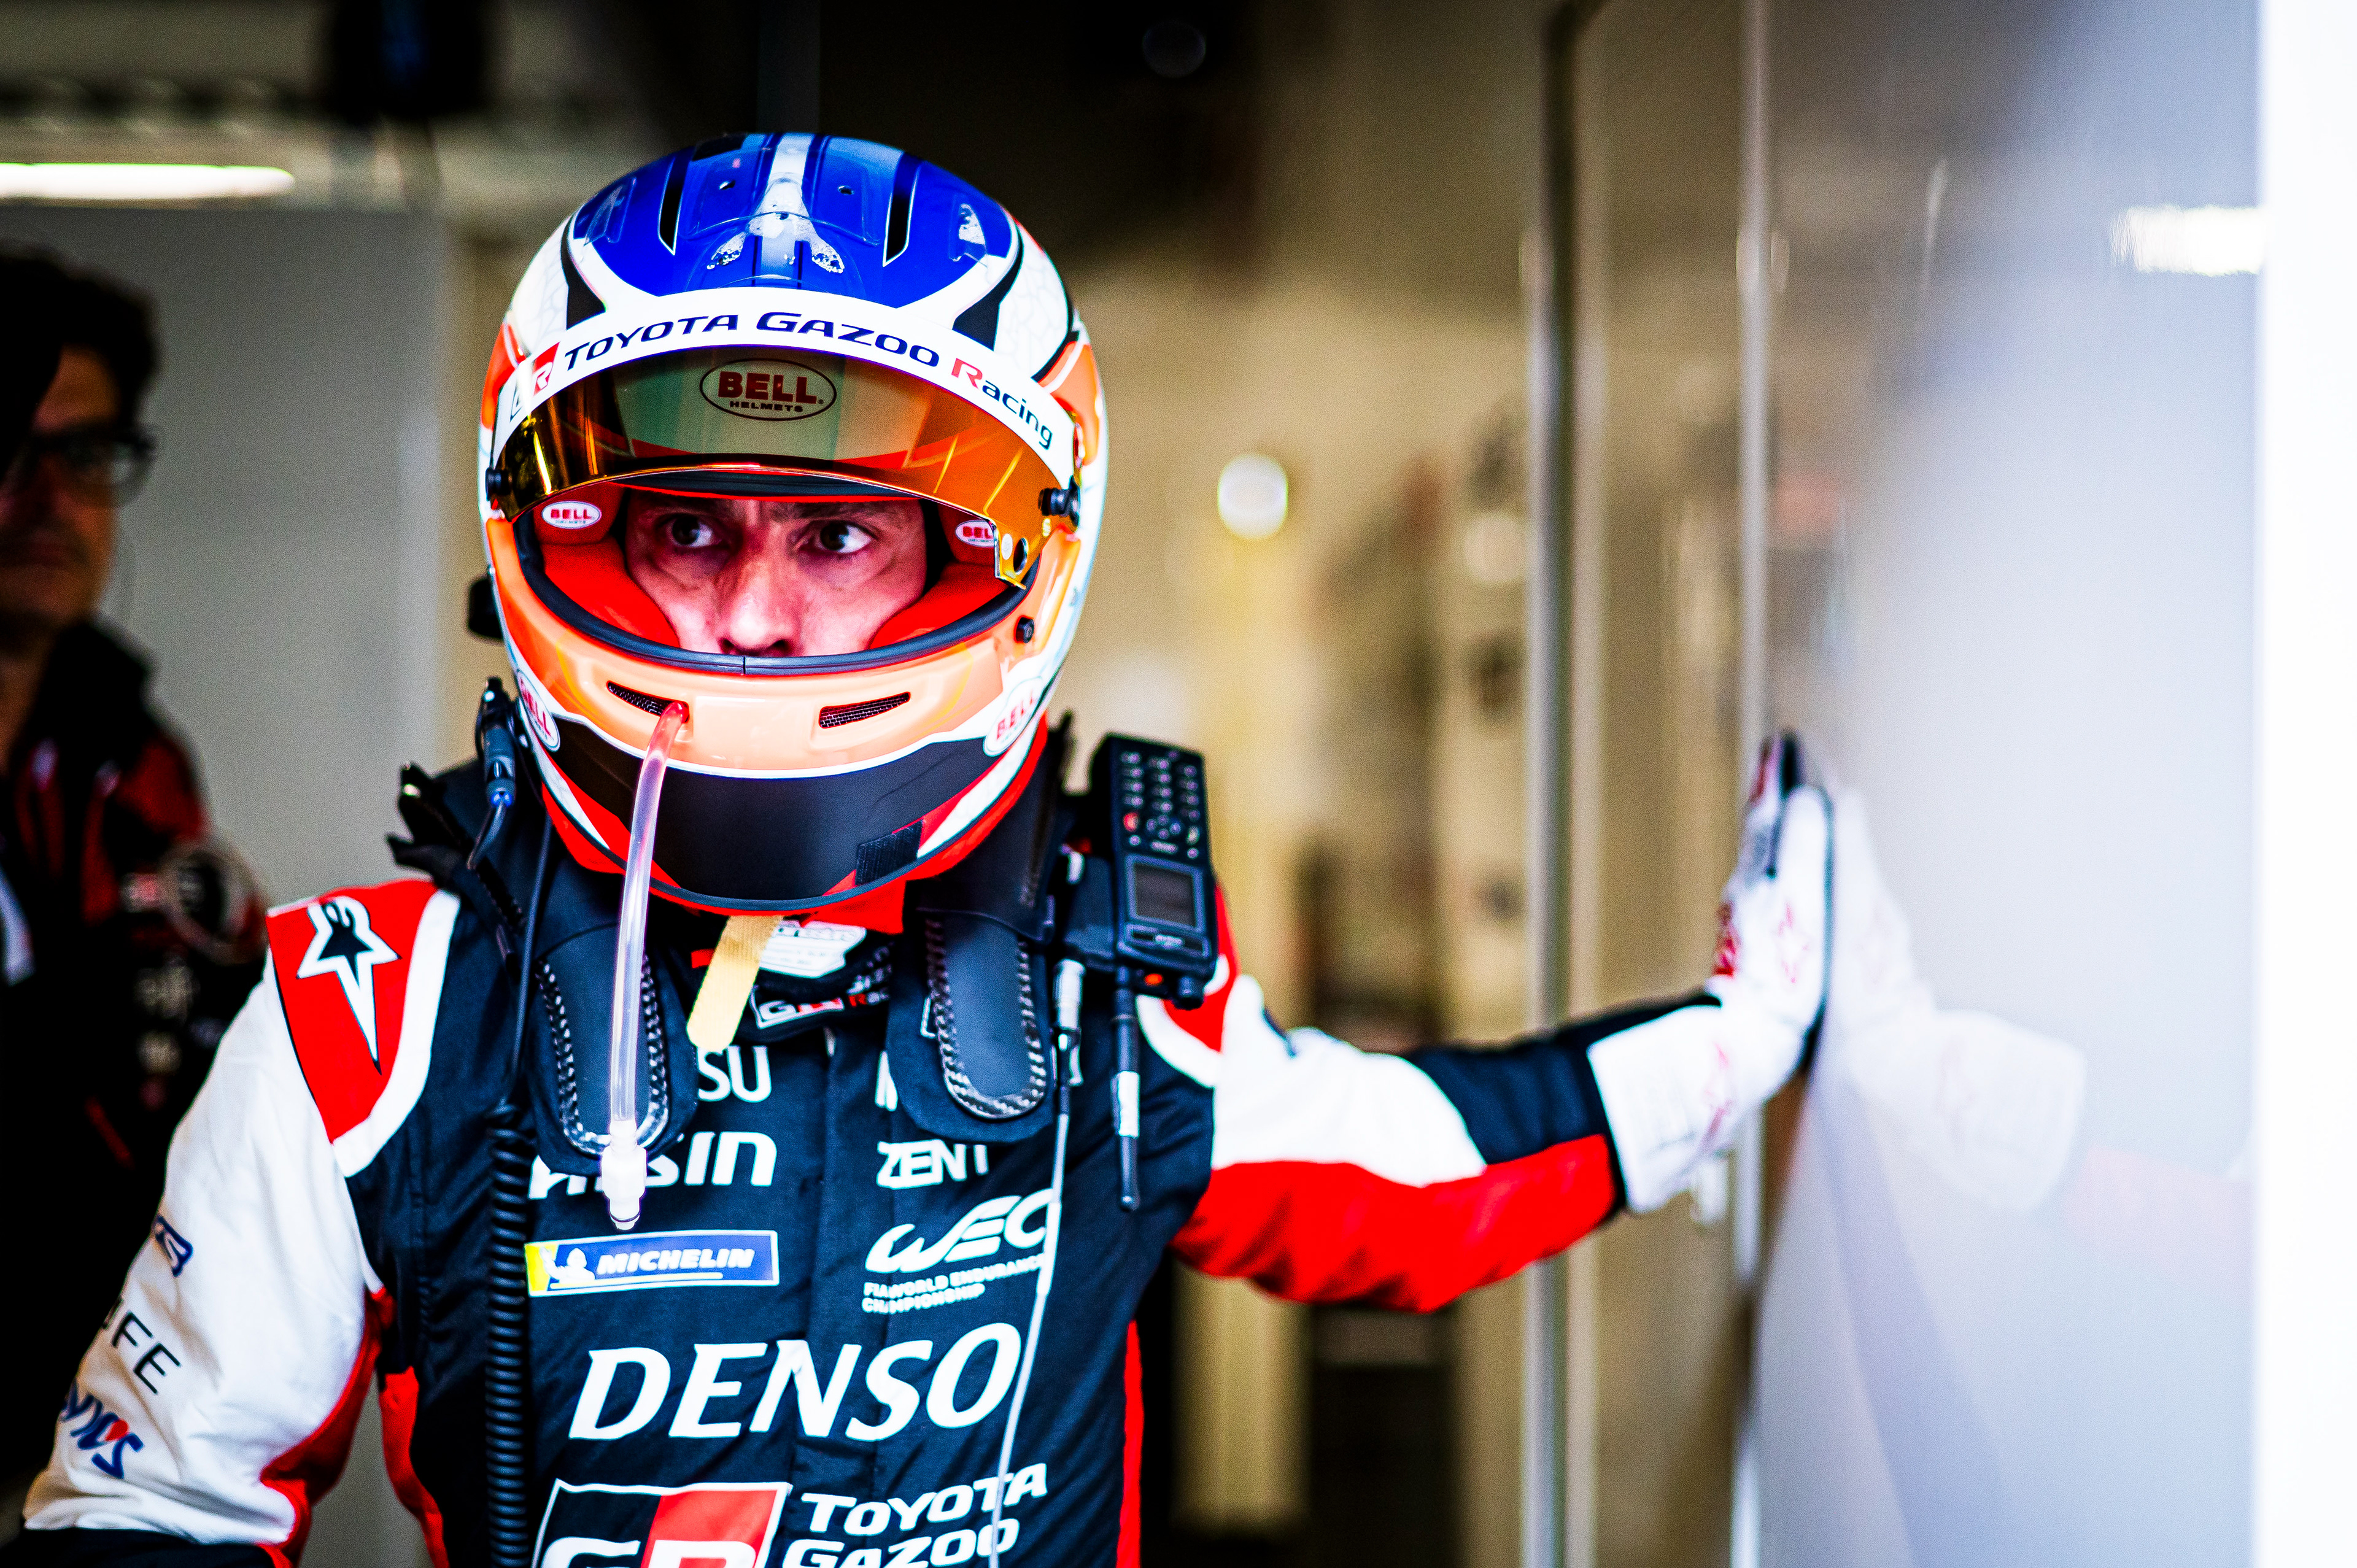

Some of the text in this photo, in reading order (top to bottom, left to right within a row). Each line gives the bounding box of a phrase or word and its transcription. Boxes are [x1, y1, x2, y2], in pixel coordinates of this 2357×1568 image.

[564, 314, 739, 371] TOYOTA
[951, 358, 1053, 450] Racing
[729, 401, 804, 413] HELMETS
[551, 509, 592, 520] BELL
[962, 526, 993, 539] BEL
[595, 1248, 756, 1275] MICHELIN
[950, 1253, 1047, 1287] ENDURANC
[567, 1322, 1022, 1442] DENSO
[800, 1462, 1048, 1536] TOYOTA
